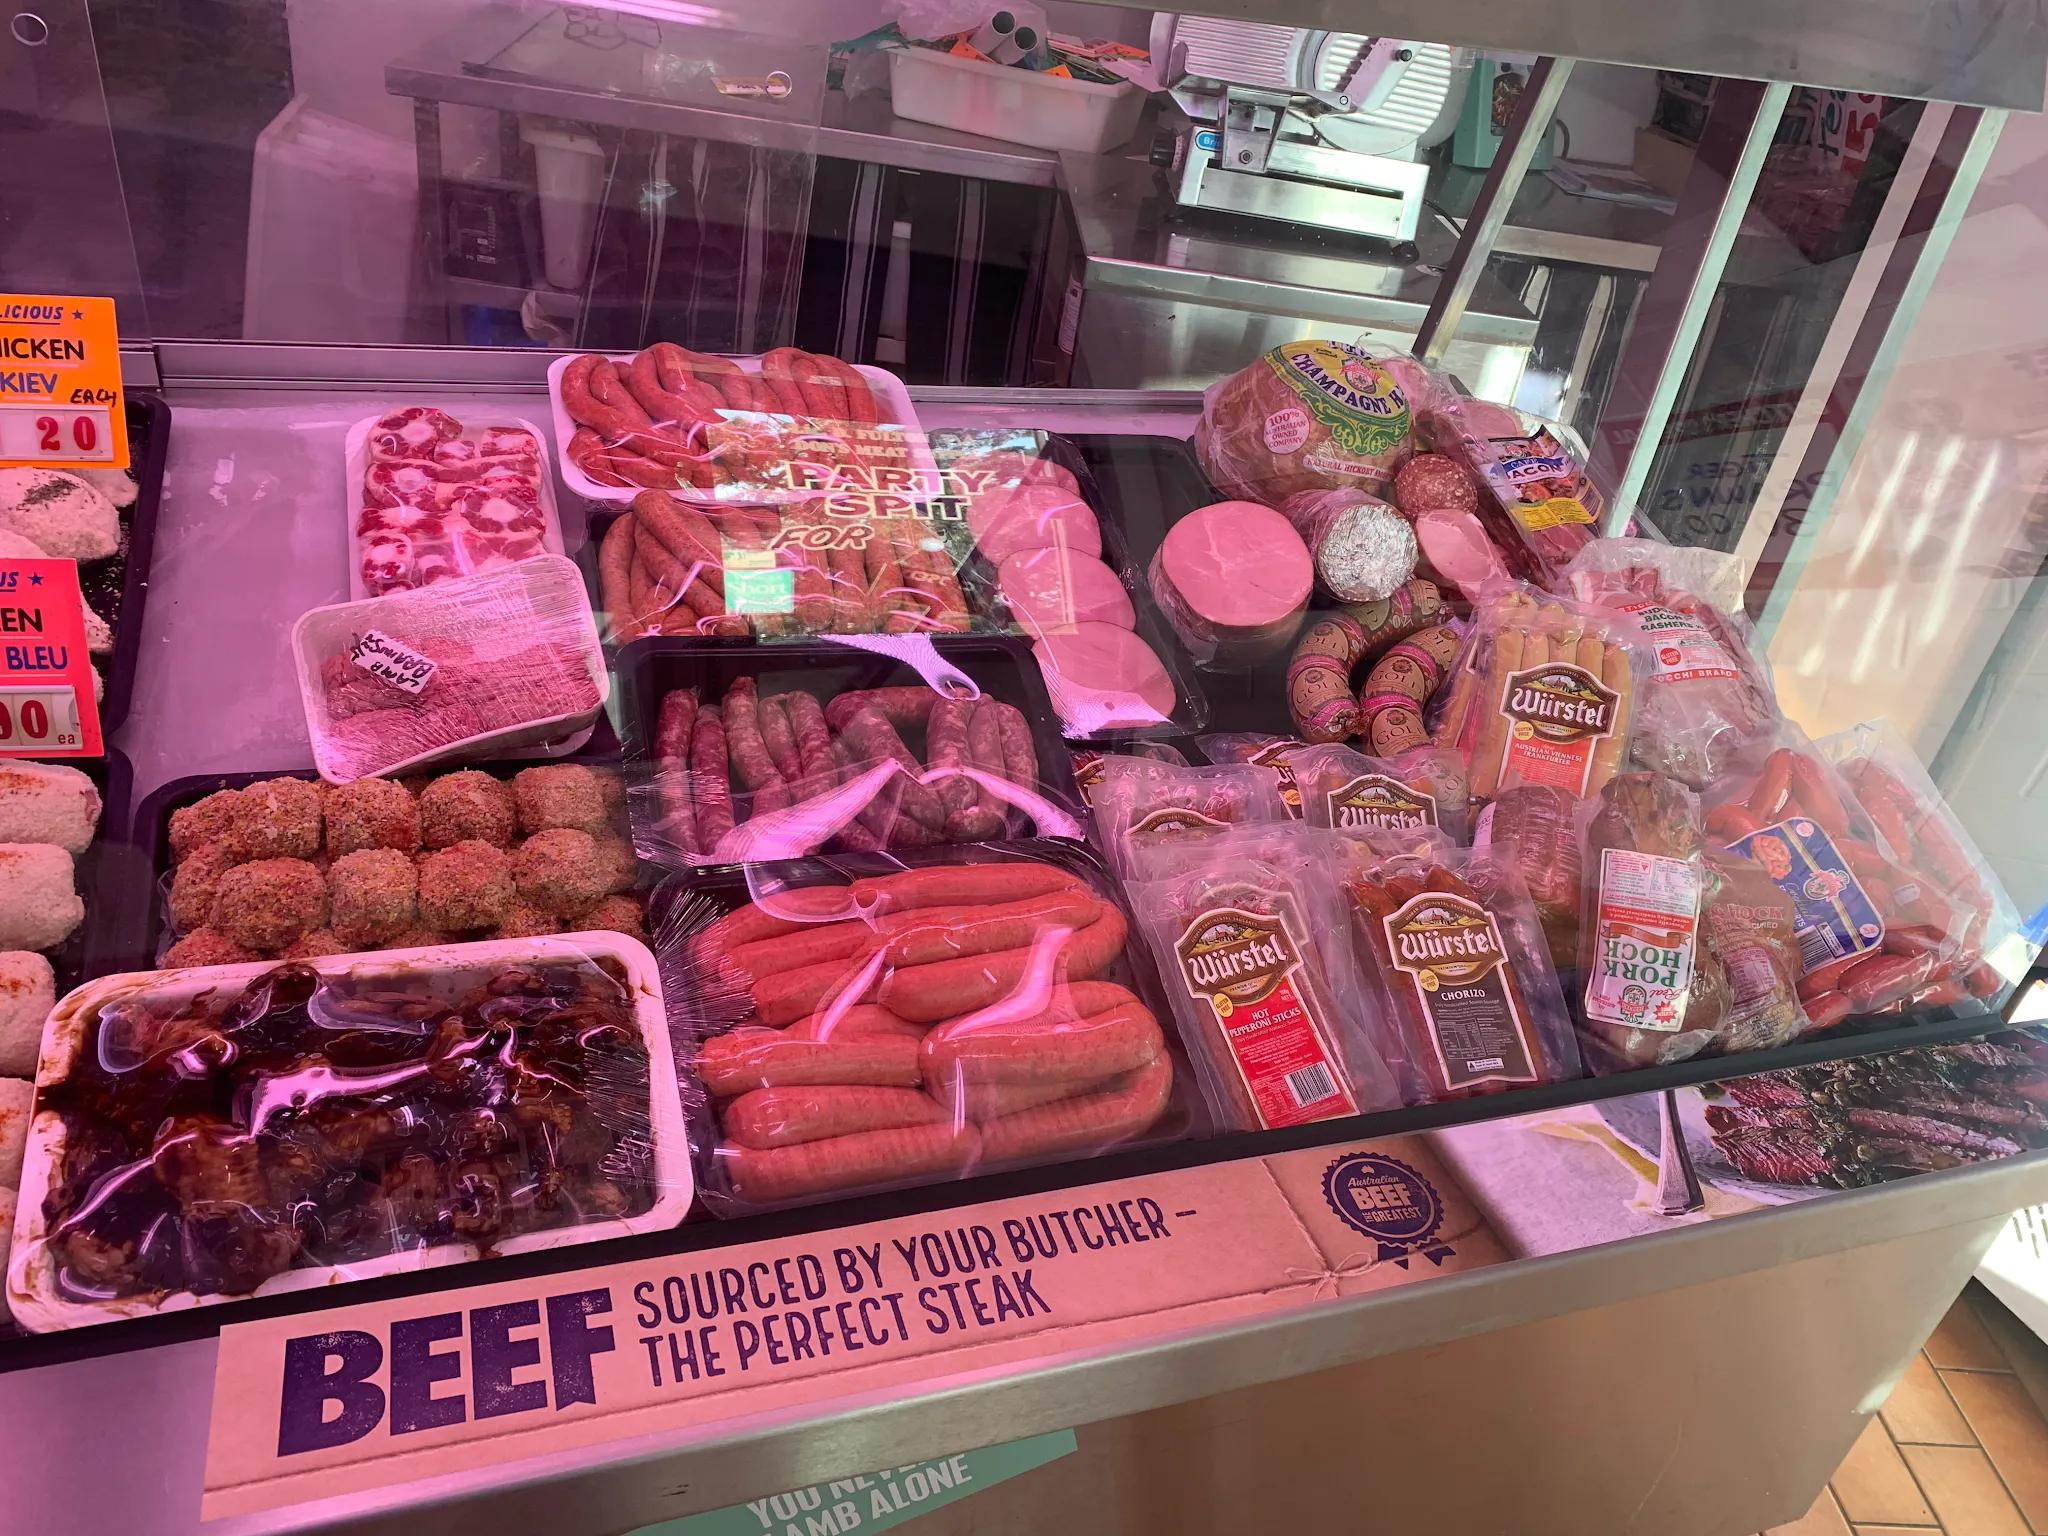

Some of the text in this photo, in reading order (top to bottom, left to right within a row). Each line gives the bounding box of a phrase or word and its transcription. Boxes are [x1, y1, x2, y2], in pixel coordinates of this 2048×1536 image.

[0, 372, 57, 393] KIEV
[1291, 353, 1391, 415] CHAMPAGNE
[70, 389, 116, 407] EACH
[1268, 411, 1300, 427] 100%
[1265, 421, 1306, 436] AUSTRALIAN
[1272, 430, 1297, 441] OWNED
[1269, 437, 1303, 448] COMPANY
[1307, 459, 1342, 471] NATURAL
[1344, 464, 1374, 476] HICKORY
[786, 460, 996, 496] PARTY
[825, 493, 972, 521] SPIT
[769, 523, 875, 551] FOR
[1640, 621, 1693, 631] RASHERS
[1644, 614, 1681, 622] BACON
[6, 646, 67, 670] BLEU
[1660, 651, 1679, 660] GLUTEN
[1699, 669, 1732, 677] BRAND
[1371, 671, 1422, 693] GOLD
[1511, 688, 1606, 727] Würstel
[58, 734, 76, 744] ea
[1515, 743, 1583, 762] AUSTRIAN VIENNESE
[1524, 751, 1571, 765] FRANKFURTER
[1626, 910, 1658, 919] traditional
[1727, 904, 1784, 920] HOCK
[1659, 919, 1685, 929] Naturally
[1398, 926, 1500, 960] Würstel
[1188, 934, 1288, 986] Würstel
[1603, 940, 1682, 969] HOCK
[1421, 976, 1435, 984] GLUTEN
[1602, 959, 1678, 988] PORK
[1441, 989, 1486, 1001] CHORIZO
[1649, 988, 1683, 1000] Real
[1215, 998, 1228, 1009] GLUTEN
[1221, 1004, 1230, 1014] FREE
[1229, 1007, 1301, 1037] PEPPERONI STICKS
[1252, 1008, 1270, 1021] HOT
[1347, 1175, 1400, 1187] Australian
[1349, 1183, 1413, 1210] BEEF
[1362, 1206, 1422, 1223] THE GREATEST
[633, 1254, 827, 1329] SOURCED
[833, 1242, 883, 1294] BY
[892, 1225, 1002, 1282] YOUR
[1002, 1197, 1172, 1263] BUTCHER
[639, 1269, 1052, 1387] THE PERFECT STEAK
[277, 1287, 616, 1458] BEEF
[870, 1453, 972, 1520] ALONE
[746, 1487, 822, 1529] YOU
